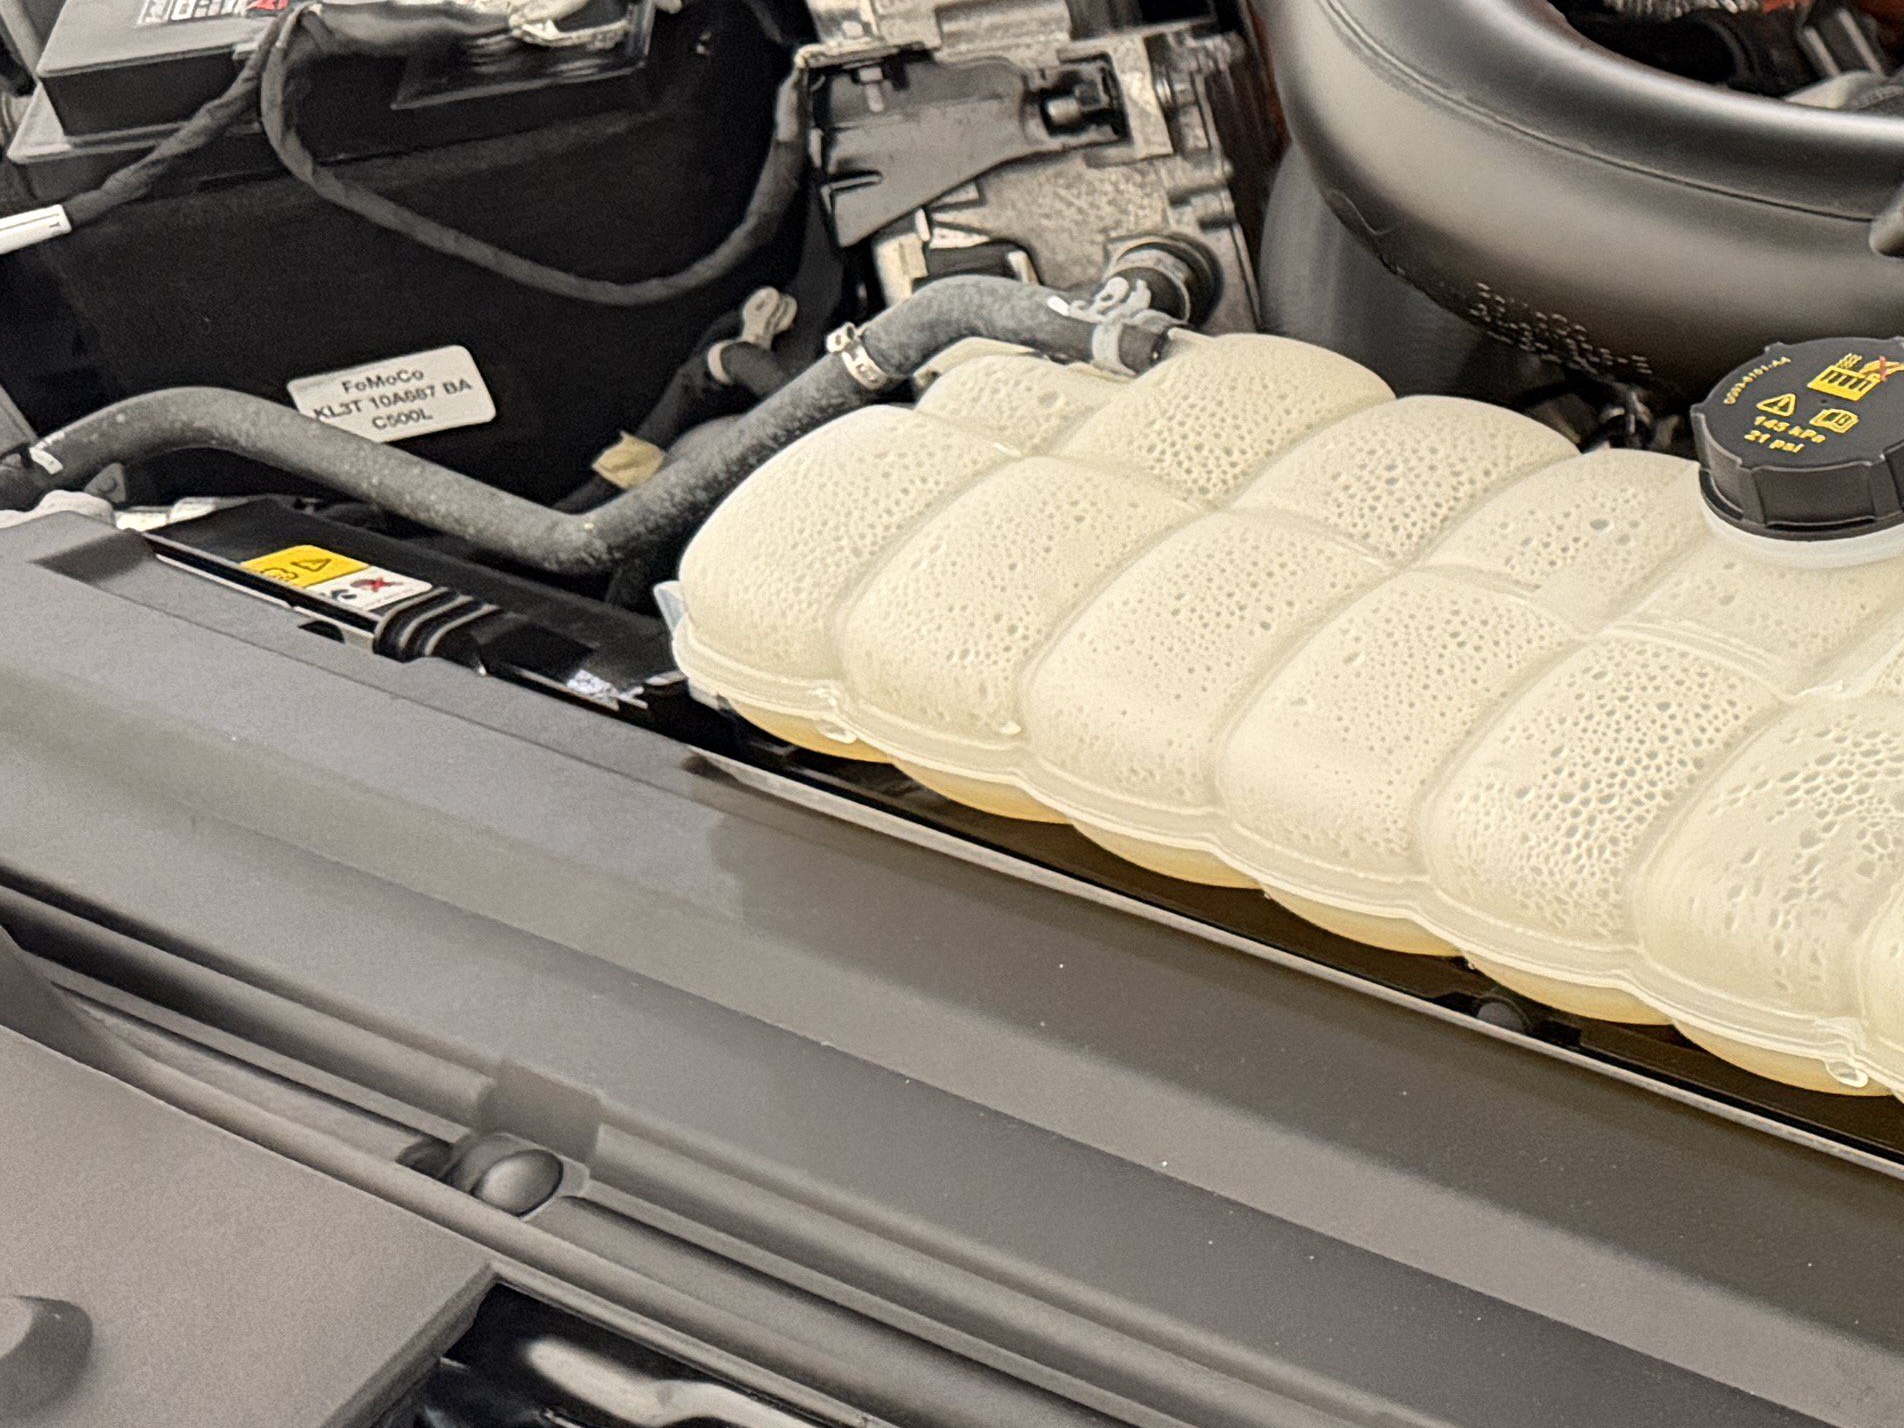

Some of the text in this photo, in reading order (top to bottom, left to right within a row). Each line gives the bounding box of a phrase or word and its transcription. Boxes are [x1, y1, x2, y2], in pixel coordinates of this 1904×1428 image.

[342, 369, 424, 395] FoMoCo
[313, 399, 362, 421] KL3T
[1744, 429, 1804, 454] 21 psi
[1754, 415, 1827, 444] 145 kPa
